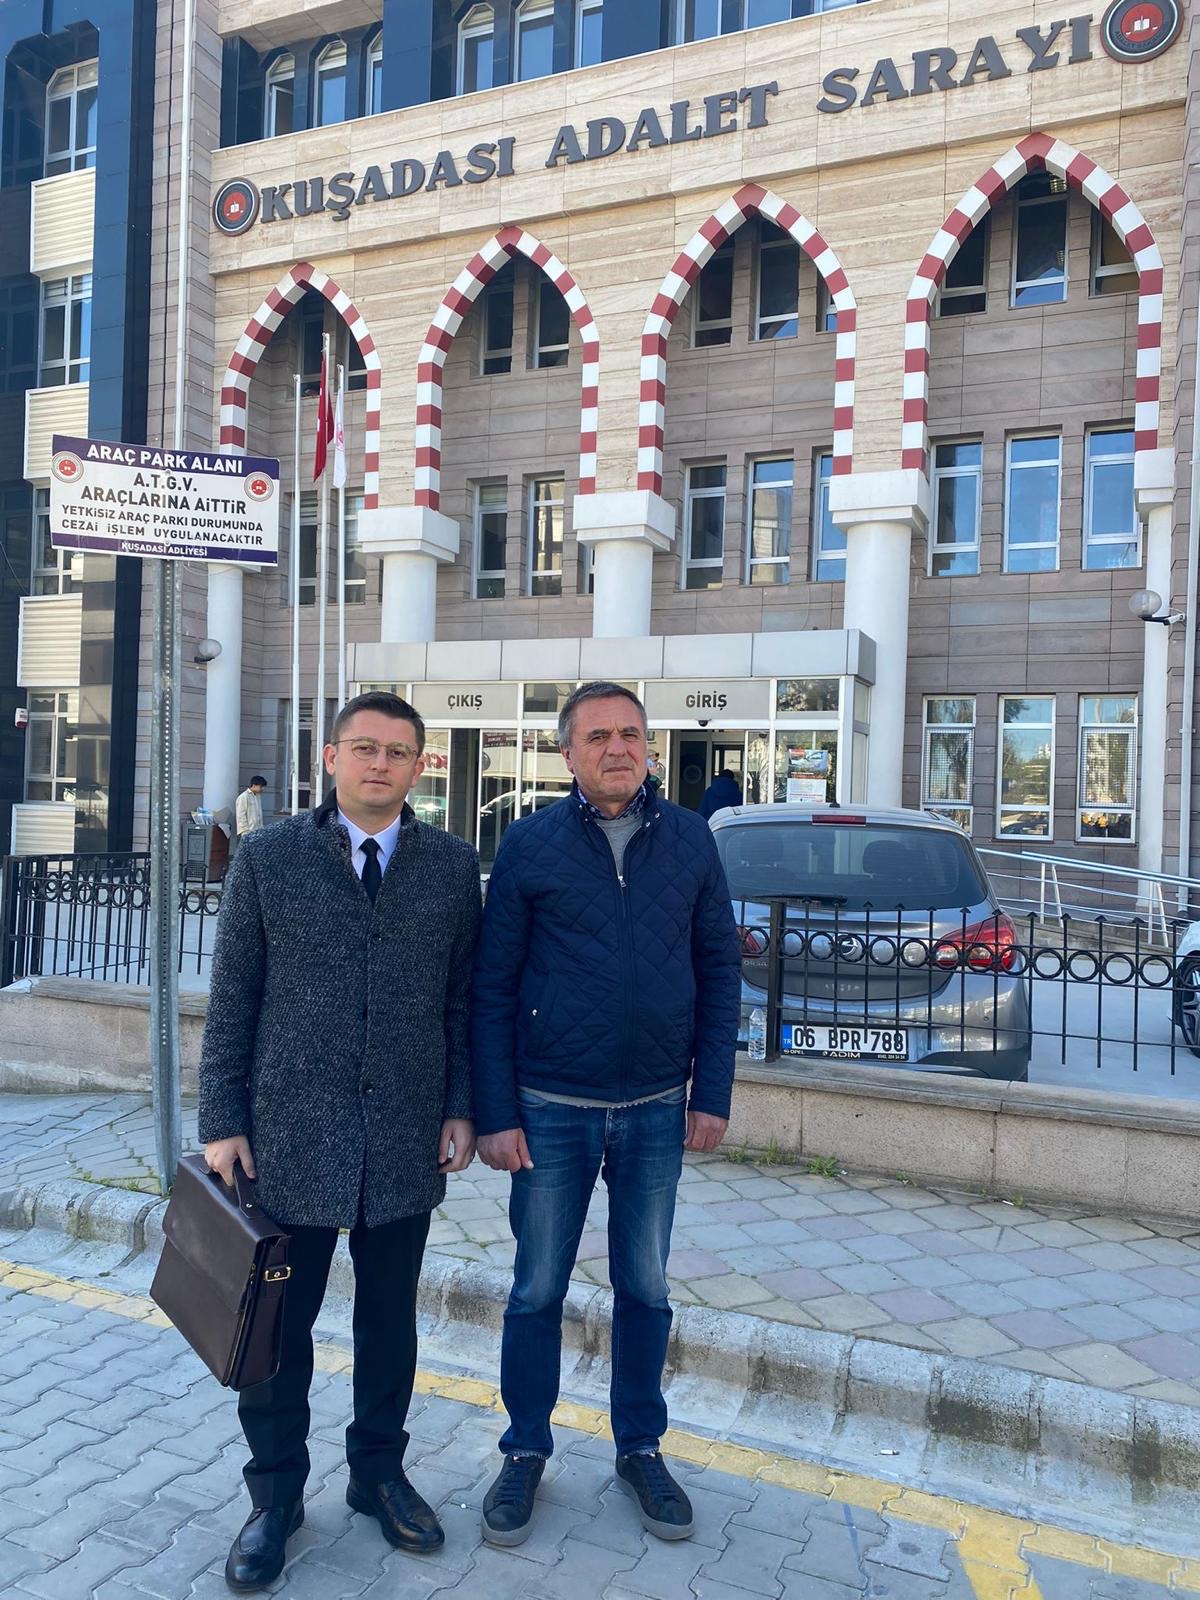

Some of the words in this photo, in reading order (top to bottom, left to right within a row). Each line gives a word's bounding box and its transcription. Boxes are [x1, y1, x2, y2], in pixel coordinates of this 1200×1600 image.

[260, 136, 515, 224] KUŞADASI
[545, 80, 779, 168] ADALET
[816, 13, 1093, 113] SARAYI
[86, 444, 136, 466] ARAÇ
[140, 450, 187, 469] PARK
[190, 456, 243, 474] ALANI
[133, 472, 198, 492] A.T.G.V.
[80, 485, 191, 511] ARAÇLARINA
[118, 511, 150, 524] ARAÇ
[153, 514, 188, 527] PARKI
[191, 517, 263, 532] DURUMUNDA
[154, 528, 263, 546] UYGULANACAKTIR
[447, 694, 483, 710] ÇIKIŞ
[685, 690, 728, 711] GİRİŞ
[794, 1027, 816, 1049] 06
[828, 1029, 861, 1051] BPR
[871, 1031, 904, 1053] 788
